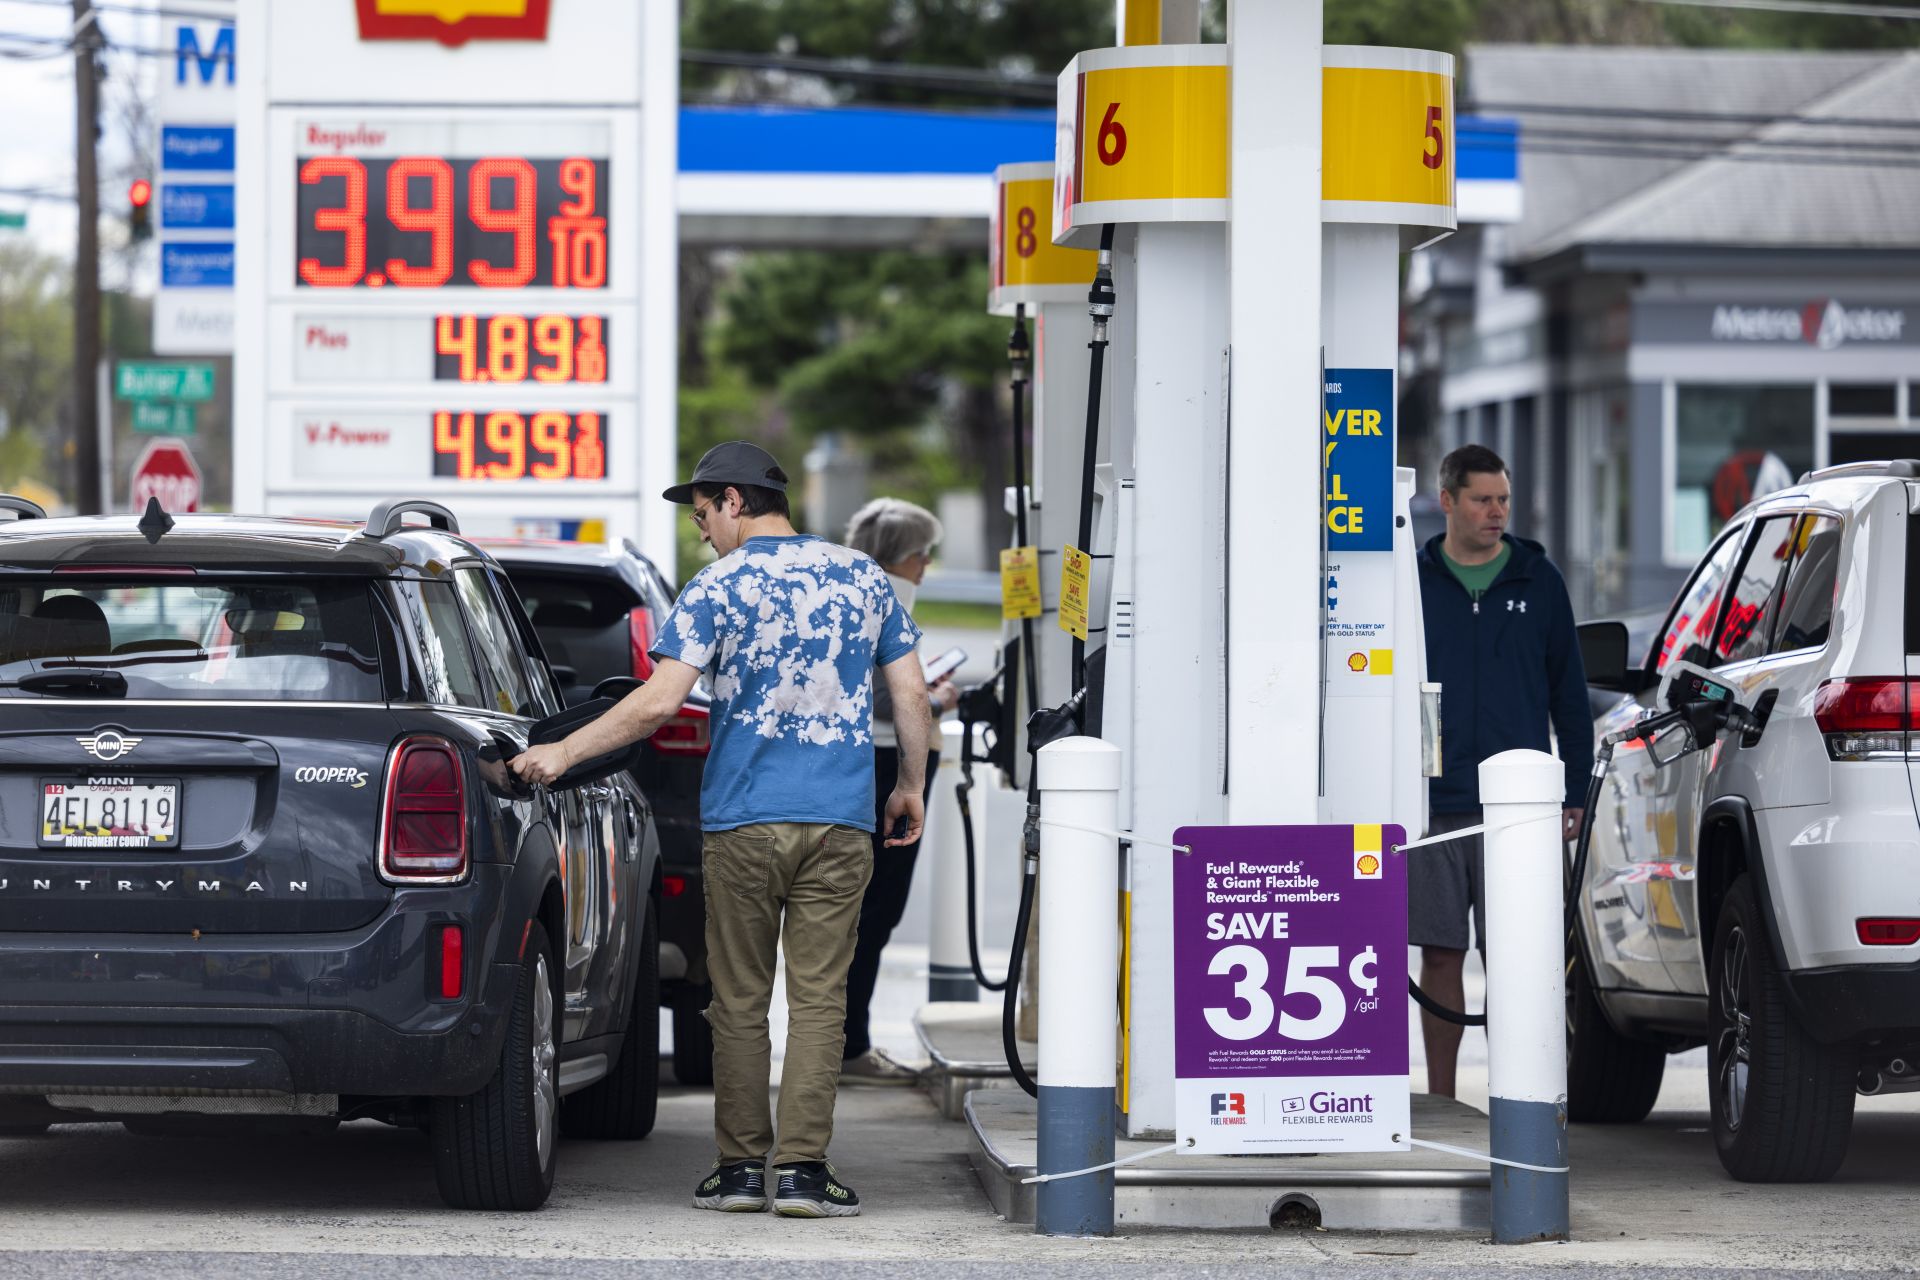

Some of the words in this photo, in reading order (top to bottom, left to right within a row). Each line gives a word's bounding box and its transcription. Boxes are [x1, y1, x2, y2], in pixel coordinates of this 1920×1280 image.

[307, 125, 386, 150] Regular
[1097, 102, 1127, 166] 6
[1423, 105, 1443, 169] 5
[559, 156, 596, 216] 9
[299, 156, 538, 288] 3.99
[1015, 206, 1037, 258] 8
[305, 325, 348, 349] Plus
[434, 312, 574, 384] 4.89
[304, 423, 391, 447] V-Power
[433, 408, 572, 482] 4.99
[136, 474, 199, 513] STOP
[97, 741, 120, 751] MINI
[87, 777, 134, 786] MINI
[46, 797, 171, 831] 4EL8119
[65, 835, 118, 848] MONTGOMERY
[118, 835, 150, 847] COUNTY
[1206, 861, 1234, 875] Fuel
[1206, 876, 1218, 889] &
[1222, 875, 1261, 889] Giant
[1265, 874, 1320, 888] Flexible
[1274, 889, 1341, 902] members
[1206, 912, 1289, 940] SAVE
[1282, 1055, 1295, 1063] point
[1309, 1091, 1373, 1114] Giant
[1210, 1117, 1222, 1126] FUEL
[1282, 1116, 1325, 1125] FLEXIBLE
[1327, 1115, 1374, 1124] REWARDS
